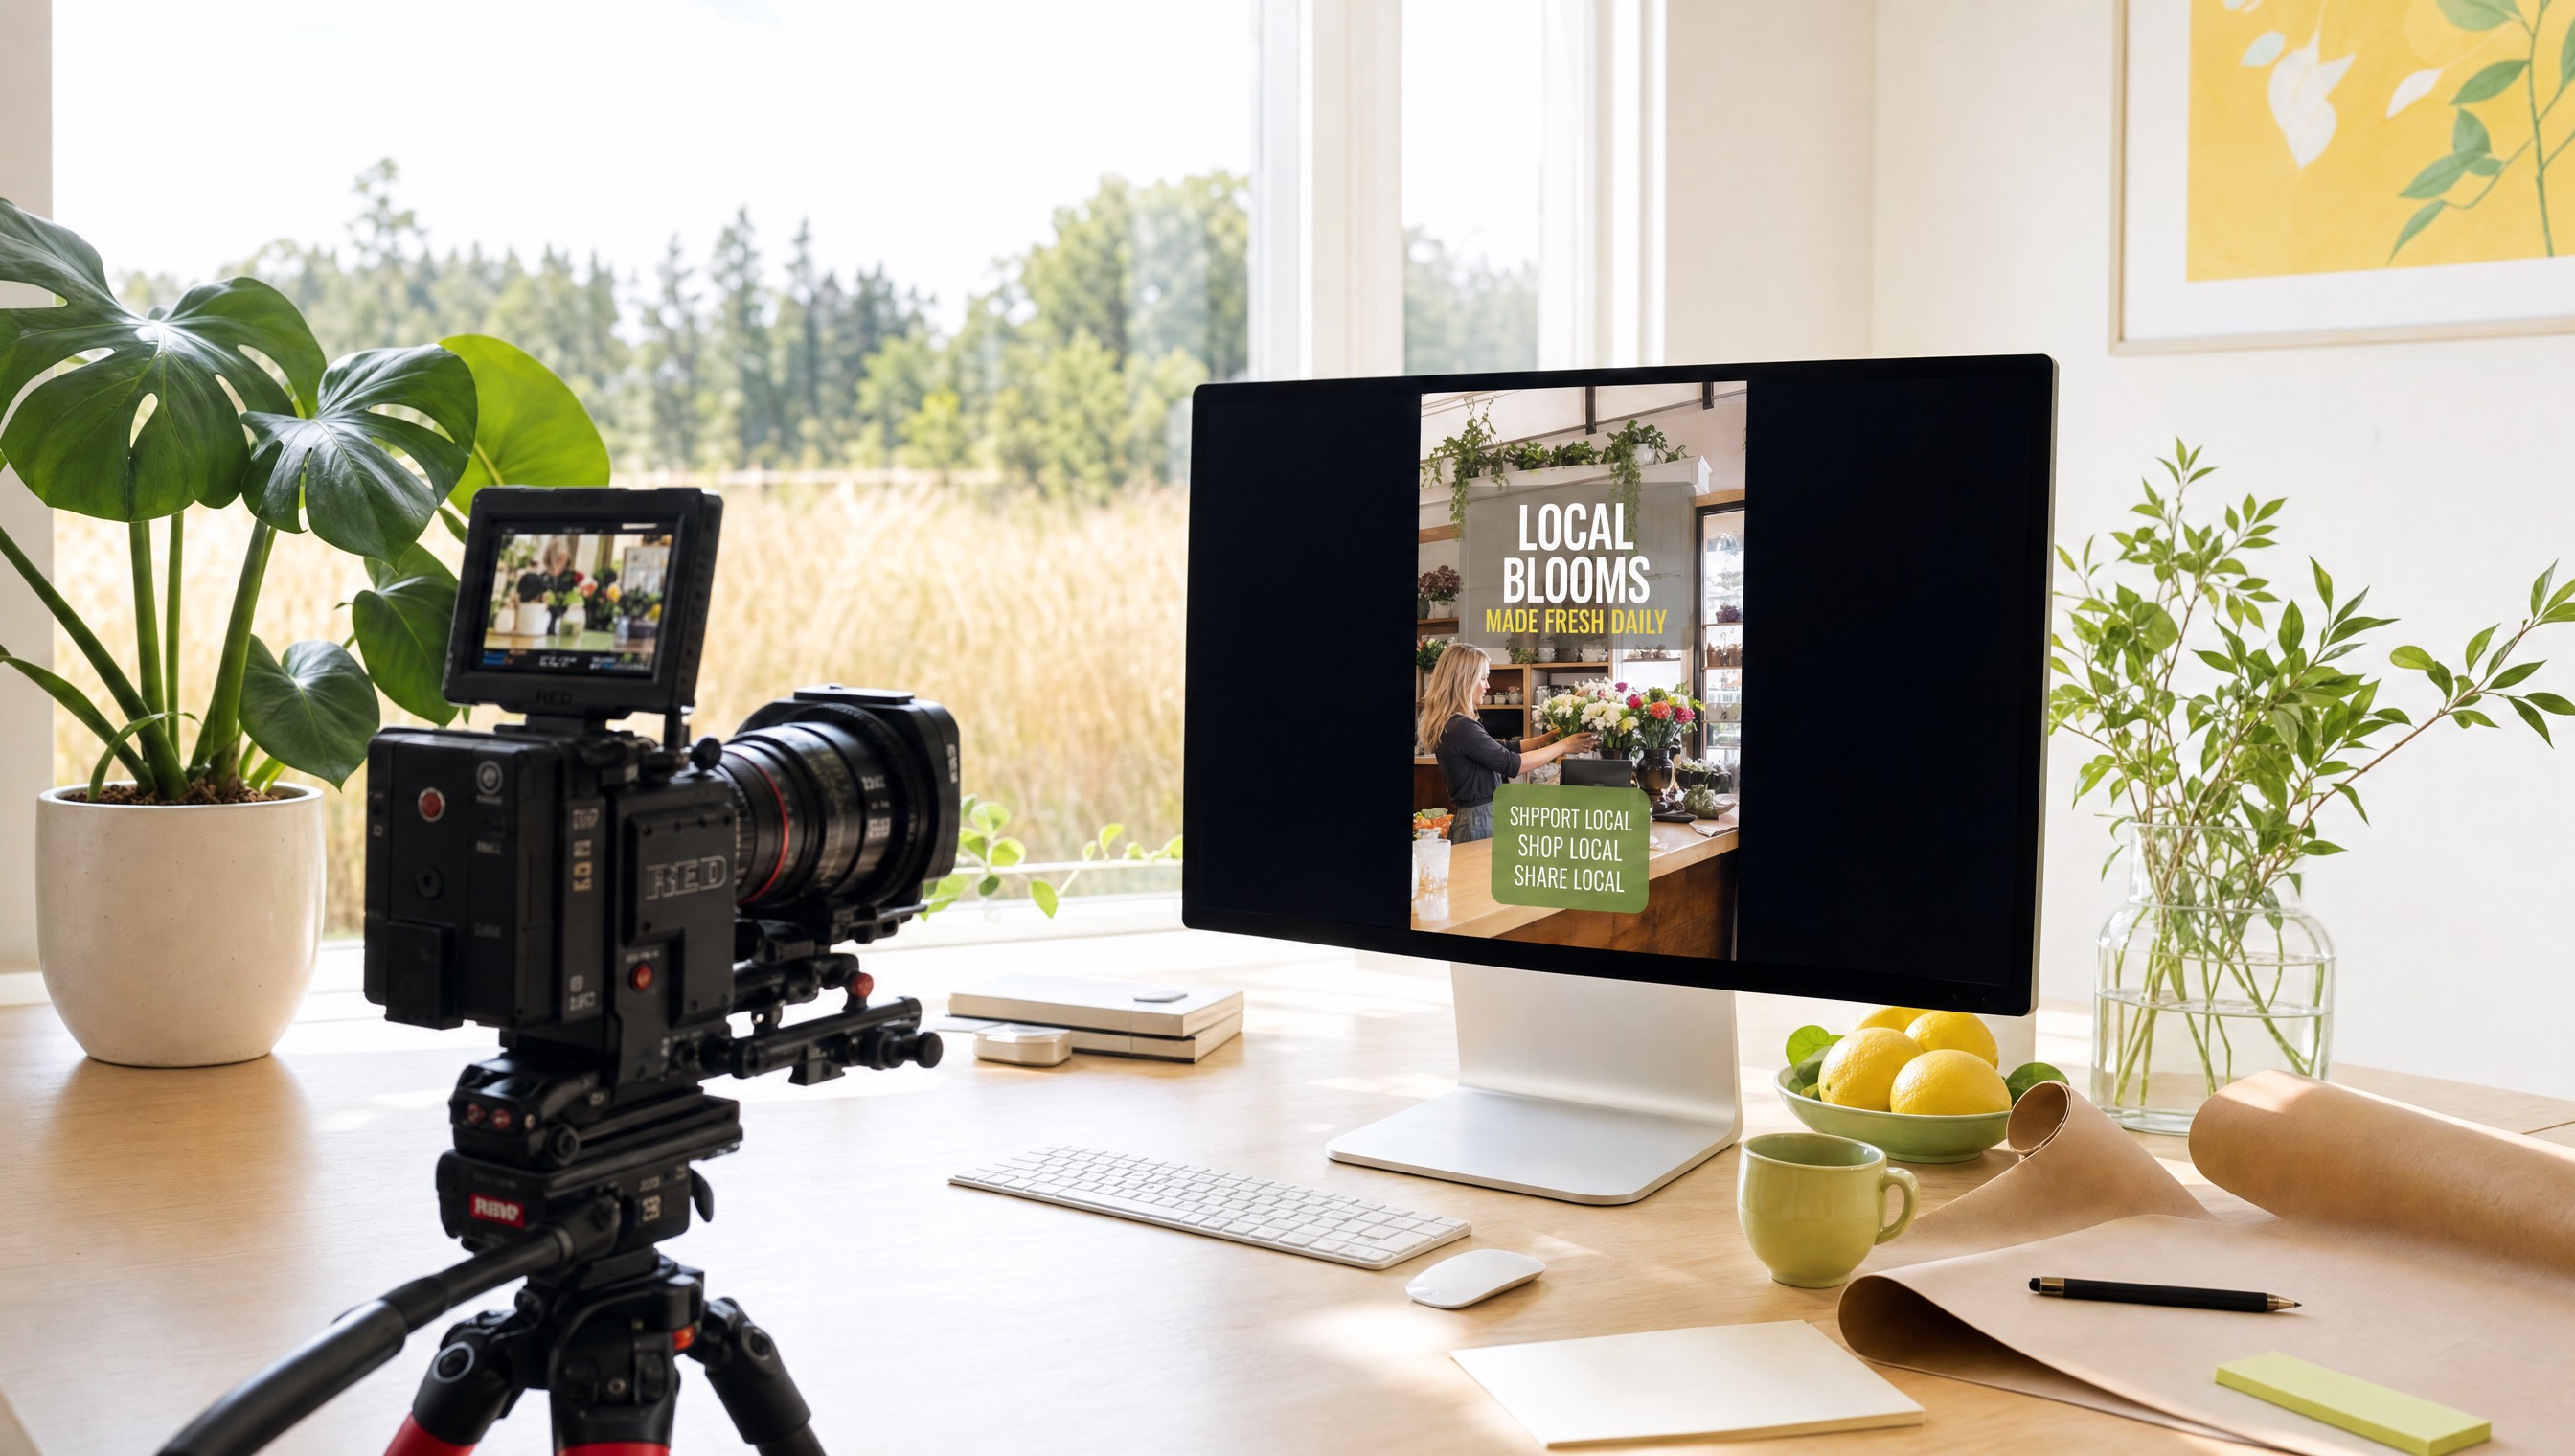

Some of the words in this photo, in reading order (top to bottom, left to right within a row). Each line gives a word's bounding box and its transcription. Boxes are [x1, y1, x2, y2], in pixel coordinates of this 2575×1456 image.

[1518, 502, 1634, 551] LOCAL
[1503, 555, 1651, 604] BLOOMS
[1486, 608, 1538, 633] MADE
[1544, 608, 1604, 634] FRESH
[1611, 608, 1668, 634] DAILY
[536, 689, 574, 706] RED
[1510, 805, 1580, 829] SHPPORT
[1584, 808, 1633, 831] LOCAL
[1517, 833, 1564, 858] SHOP
[1569, 836, 1623, 862] LOCAL
[644, 855, 728, 901] RED
[1514, 864, 1568, 890] SHARE
[1573, 868, 1625, 893] LOCAL
